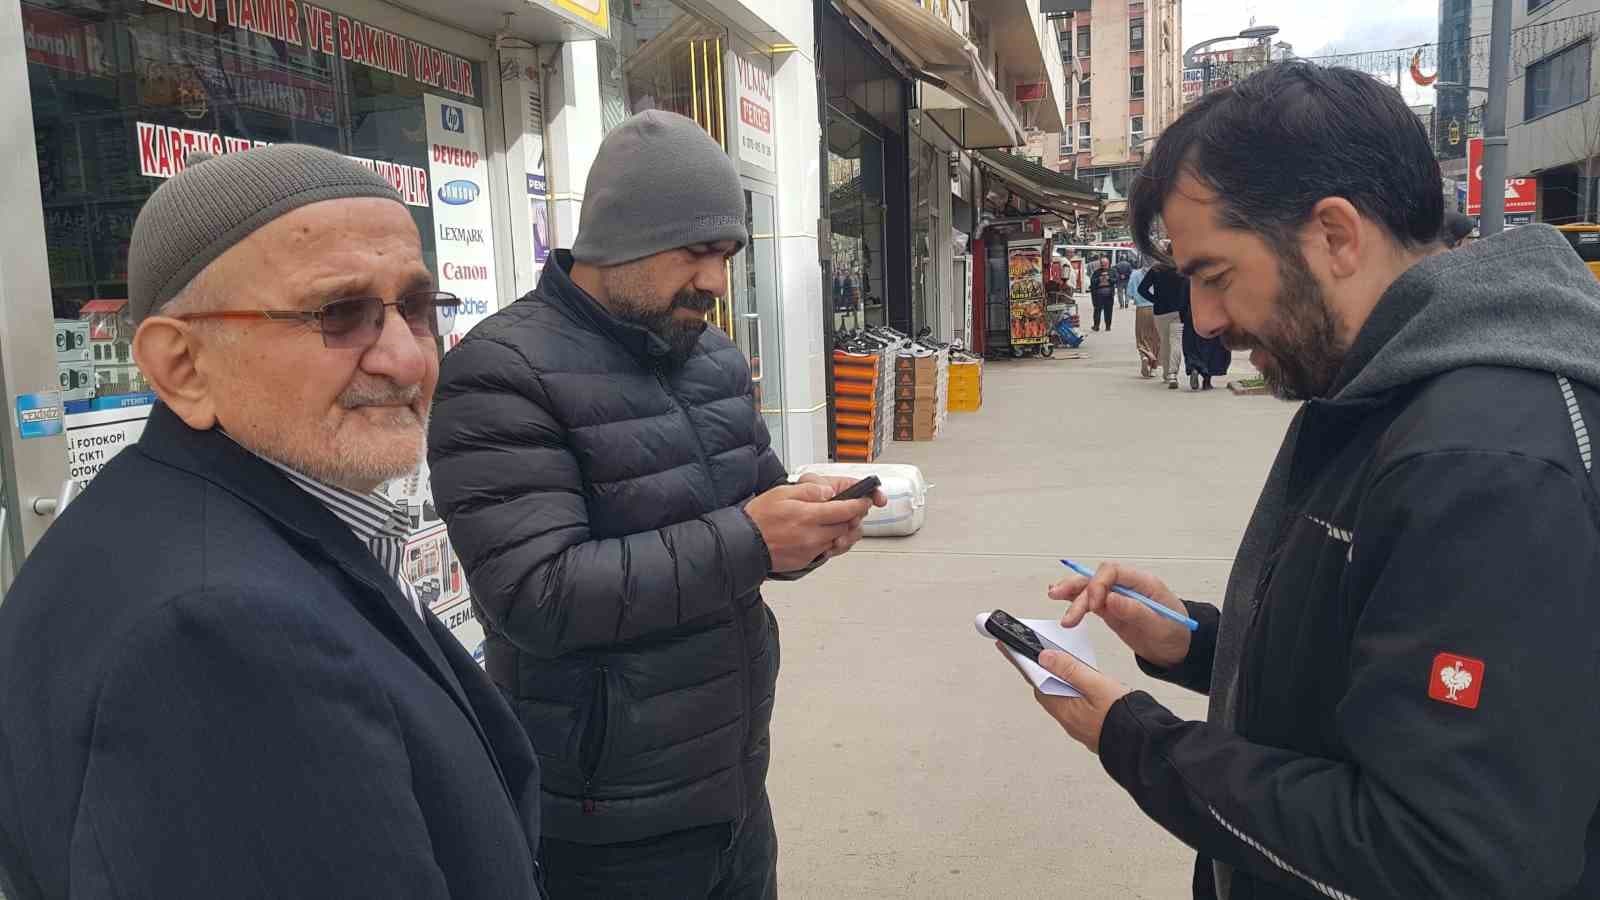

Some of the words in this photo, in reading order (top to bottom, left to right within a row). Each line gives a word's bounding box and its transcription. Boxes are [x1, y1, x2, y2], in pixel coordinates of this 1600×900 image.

[302, 3, 335, 56] VE
[337, 16, 408, 78] BAKIMI
[408, 40, 474, 97] YAPILIR
[433, 143, 479, 168] DEVELOP
[440, 182, 480, 202] SAMSUNG
[439, 223, 484, 247] LEXMARK
[442, 261, 488, 280] Canon
